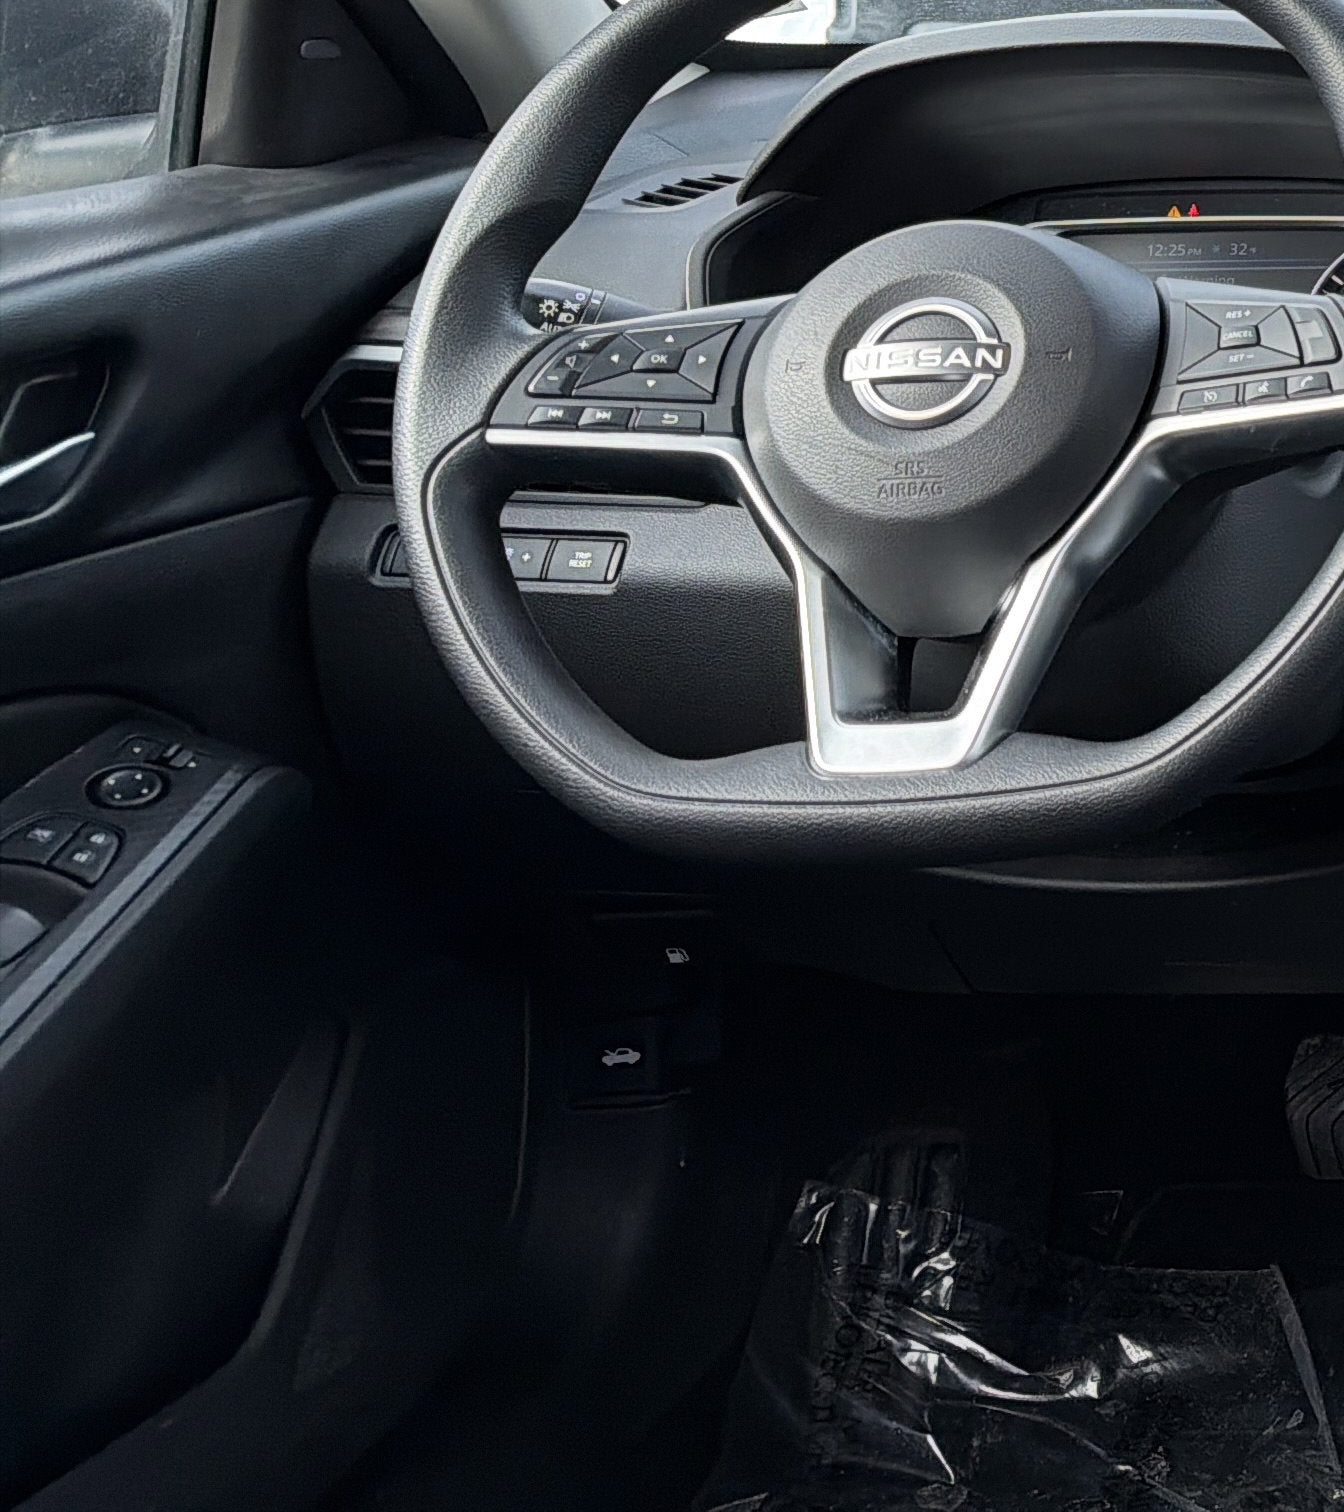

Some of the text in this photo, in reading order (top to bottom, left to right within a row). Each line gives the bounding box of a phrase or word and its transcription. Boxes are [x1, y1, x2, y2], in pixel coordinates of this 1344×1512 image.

[1148, 243, 1186, 257] 12:25
[1228, 243, 1248, 256] 32
[1225, 310, 1242, 319] RES
[1222, 330, 1254, 339] CANCEL
[650, 354, 668, 364] OK
[849, 346, 1004, 374] NISSAN
[1228, 354, 1244, 363] SET
[893, 459, 927, 477] SRS
[876, 479, 945, 500] AIRBAG
[568, 559, 593, 568] RESET
